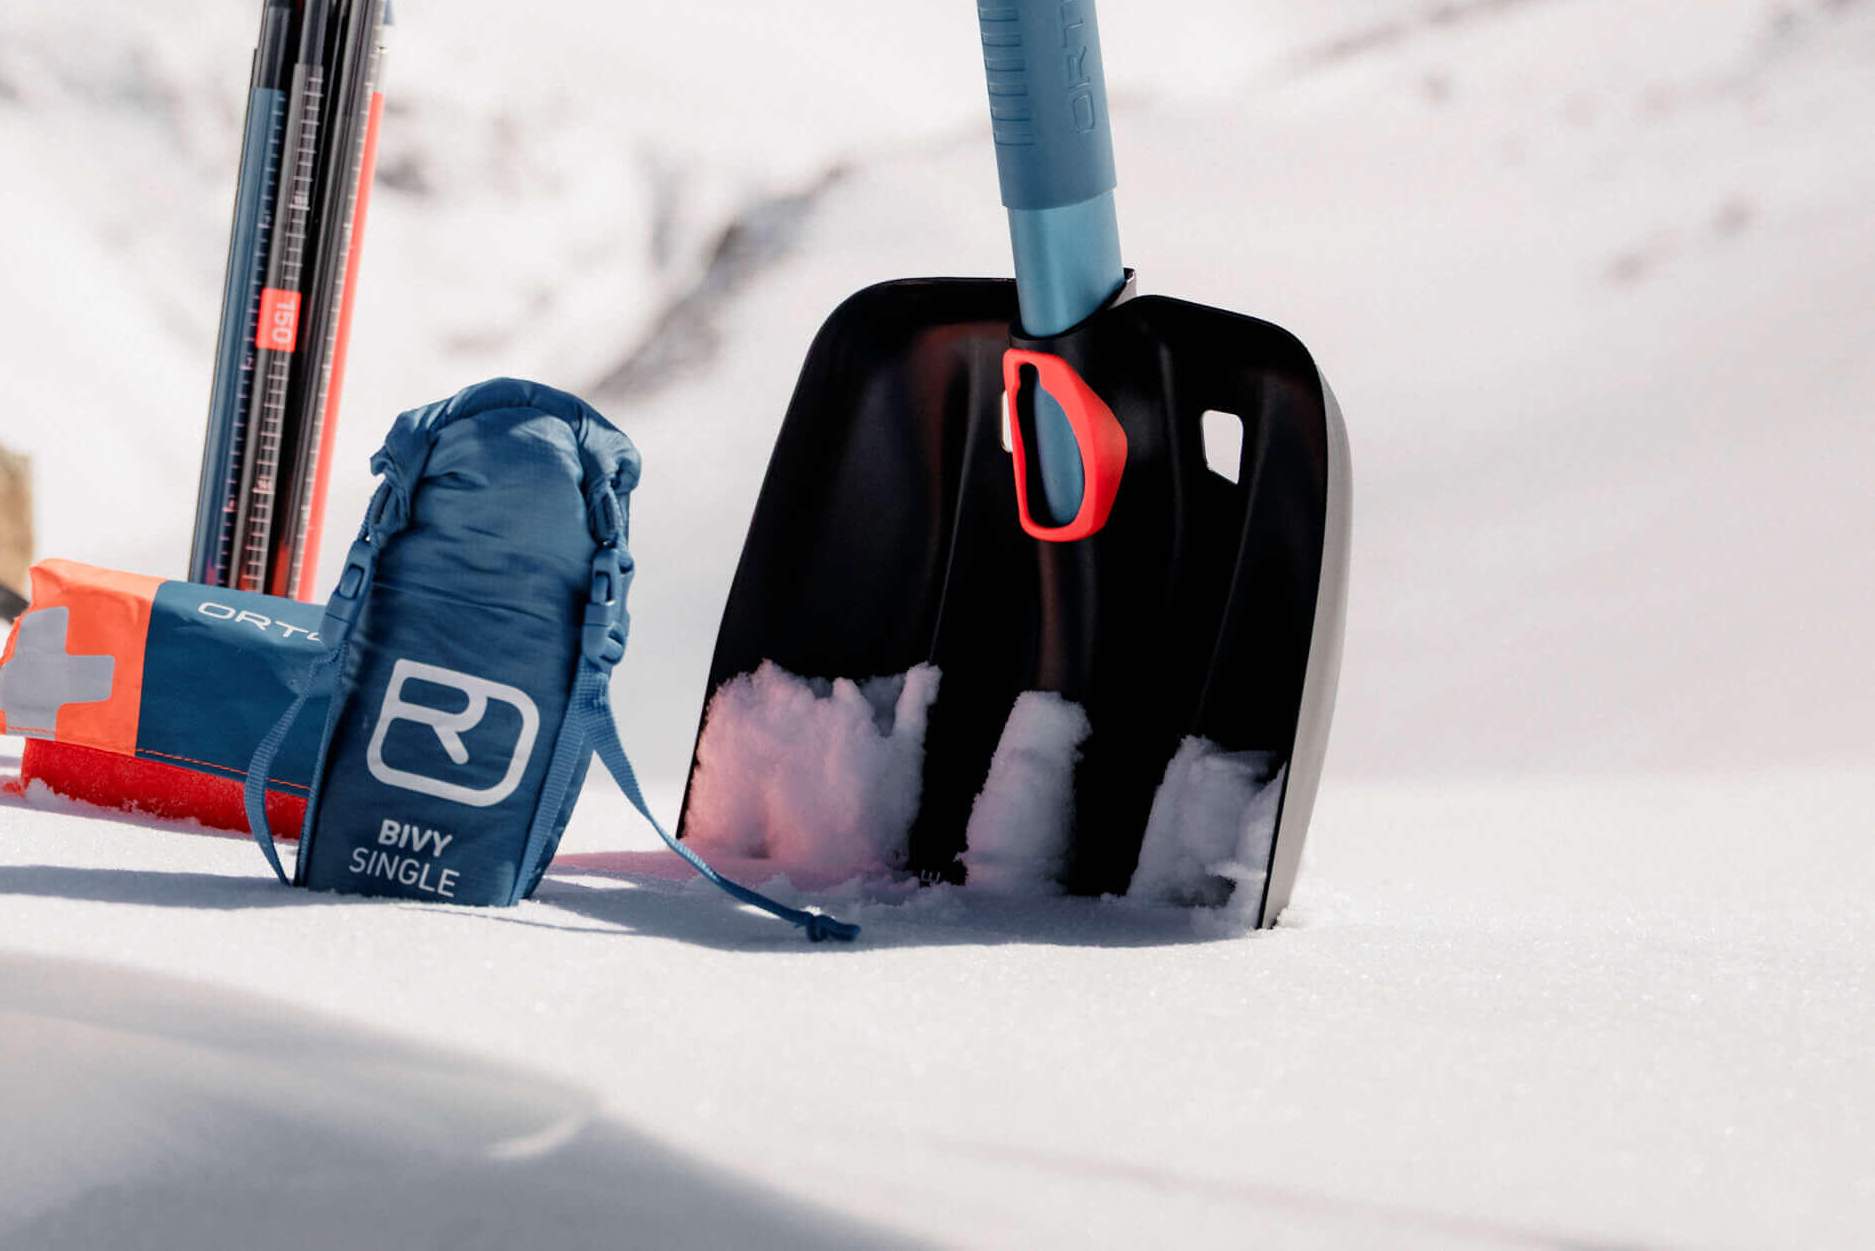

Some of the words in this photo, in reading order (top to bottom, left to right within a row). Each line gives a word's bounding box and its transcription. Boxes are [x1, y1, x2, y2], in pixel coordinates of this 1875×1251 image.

[272, 300, 296, 343] 150
[378, 819, 454, 858] BIVY
[348, 847, 460, 898] SINGLE
